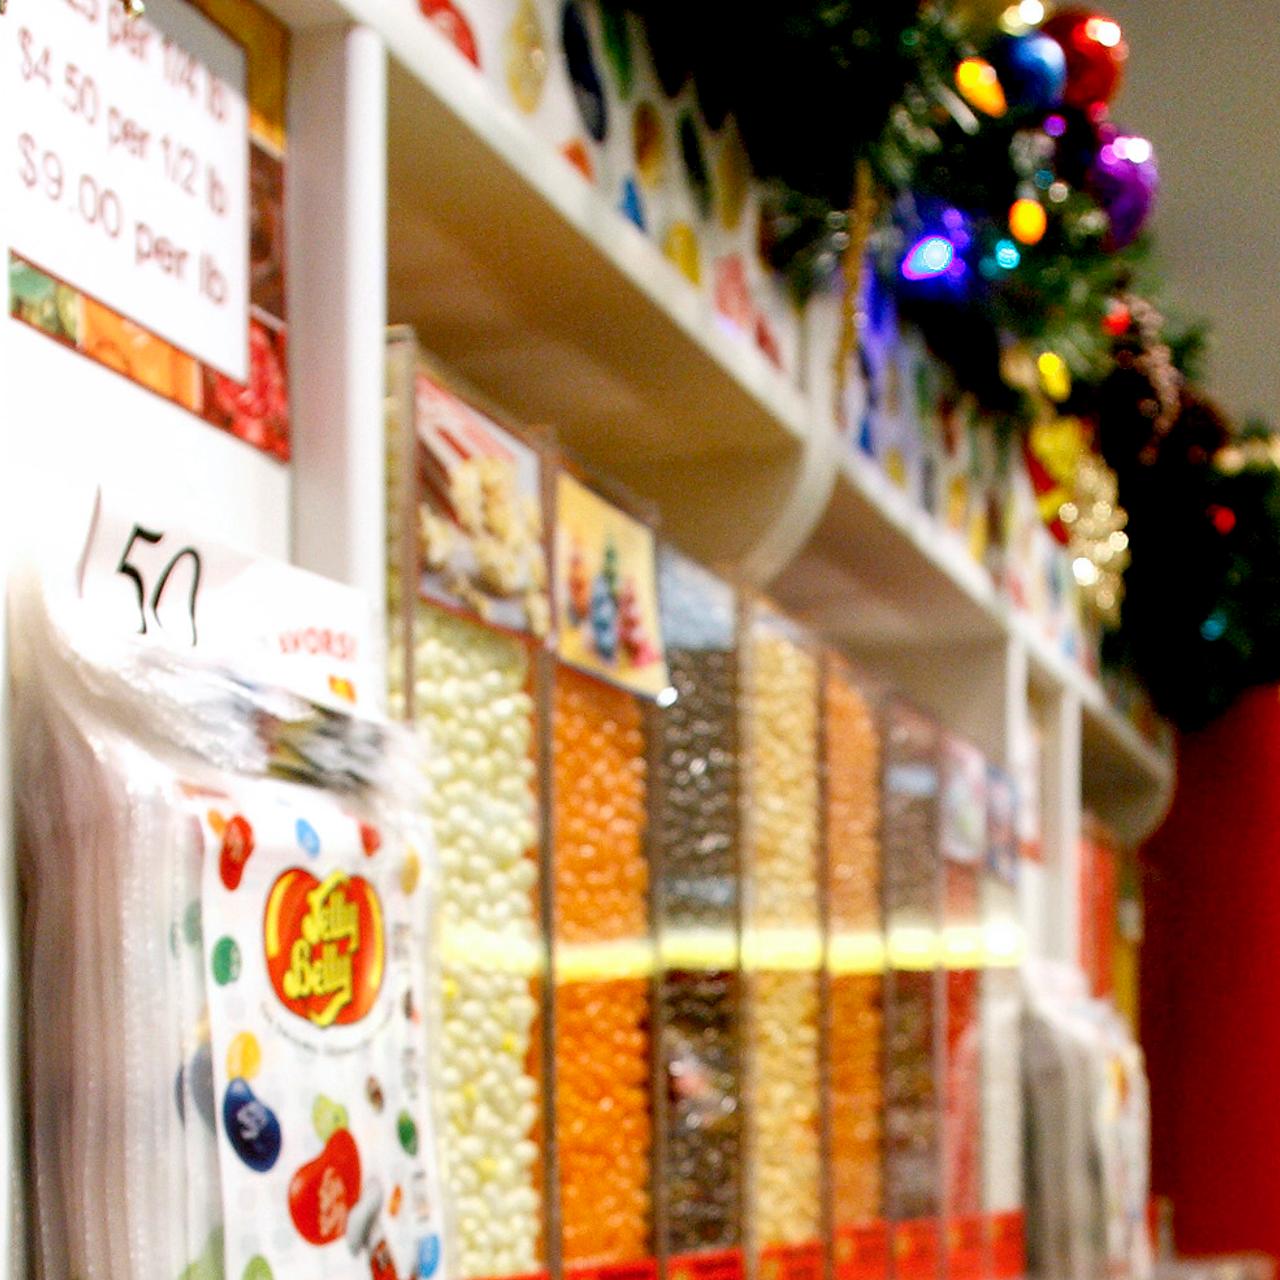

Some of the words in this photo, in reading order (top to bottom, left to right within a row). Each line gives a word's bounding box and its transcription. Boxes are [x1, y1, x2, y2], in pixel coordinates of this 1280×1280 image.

[106, 103, 152, 161] per
[133, 220, 189, 281] per
[198, 251, 230, 307] lb
